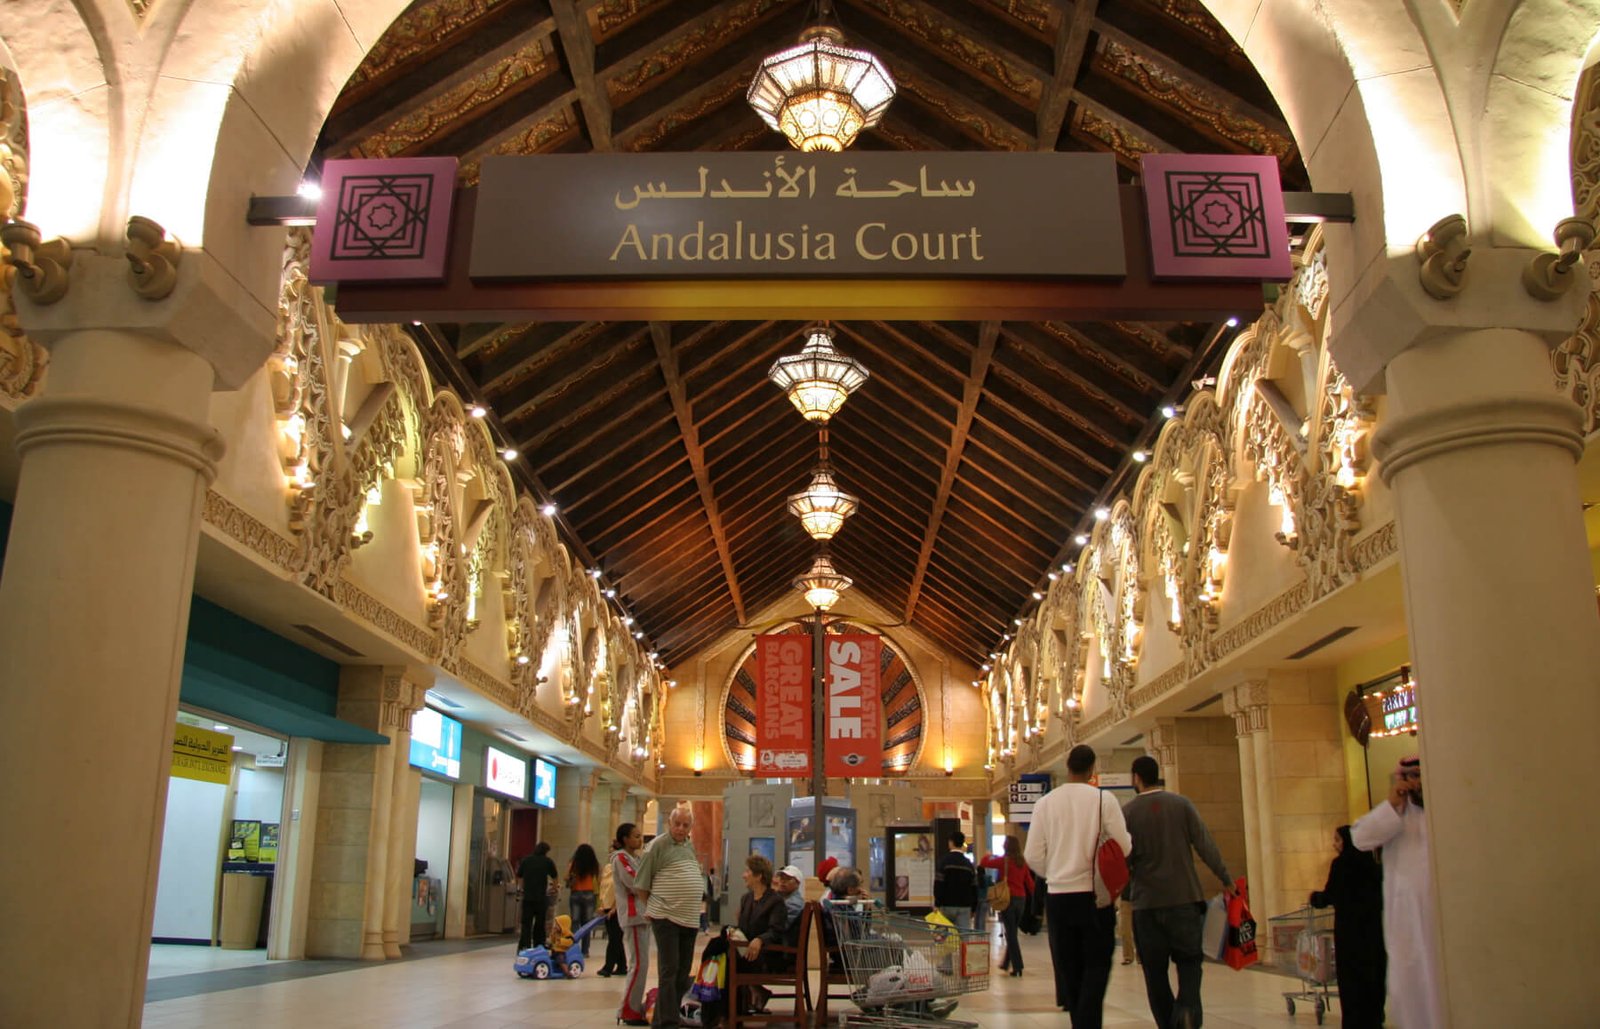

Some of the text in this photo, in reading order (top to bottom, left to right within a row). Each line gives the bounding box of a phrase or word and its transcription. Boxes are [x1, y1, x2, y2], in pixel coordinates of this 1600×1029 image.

[614, 155, 976, 210] ساحة الأندلس
[608, 220, 984, 261] Andalusia Court
[765, 641, 779, 739] BARGAINS
[780, 641, 803, 739] GREAT
[829, 640, 862, 739] SALE
[861, 640, 876, 739] FANTASTIC
